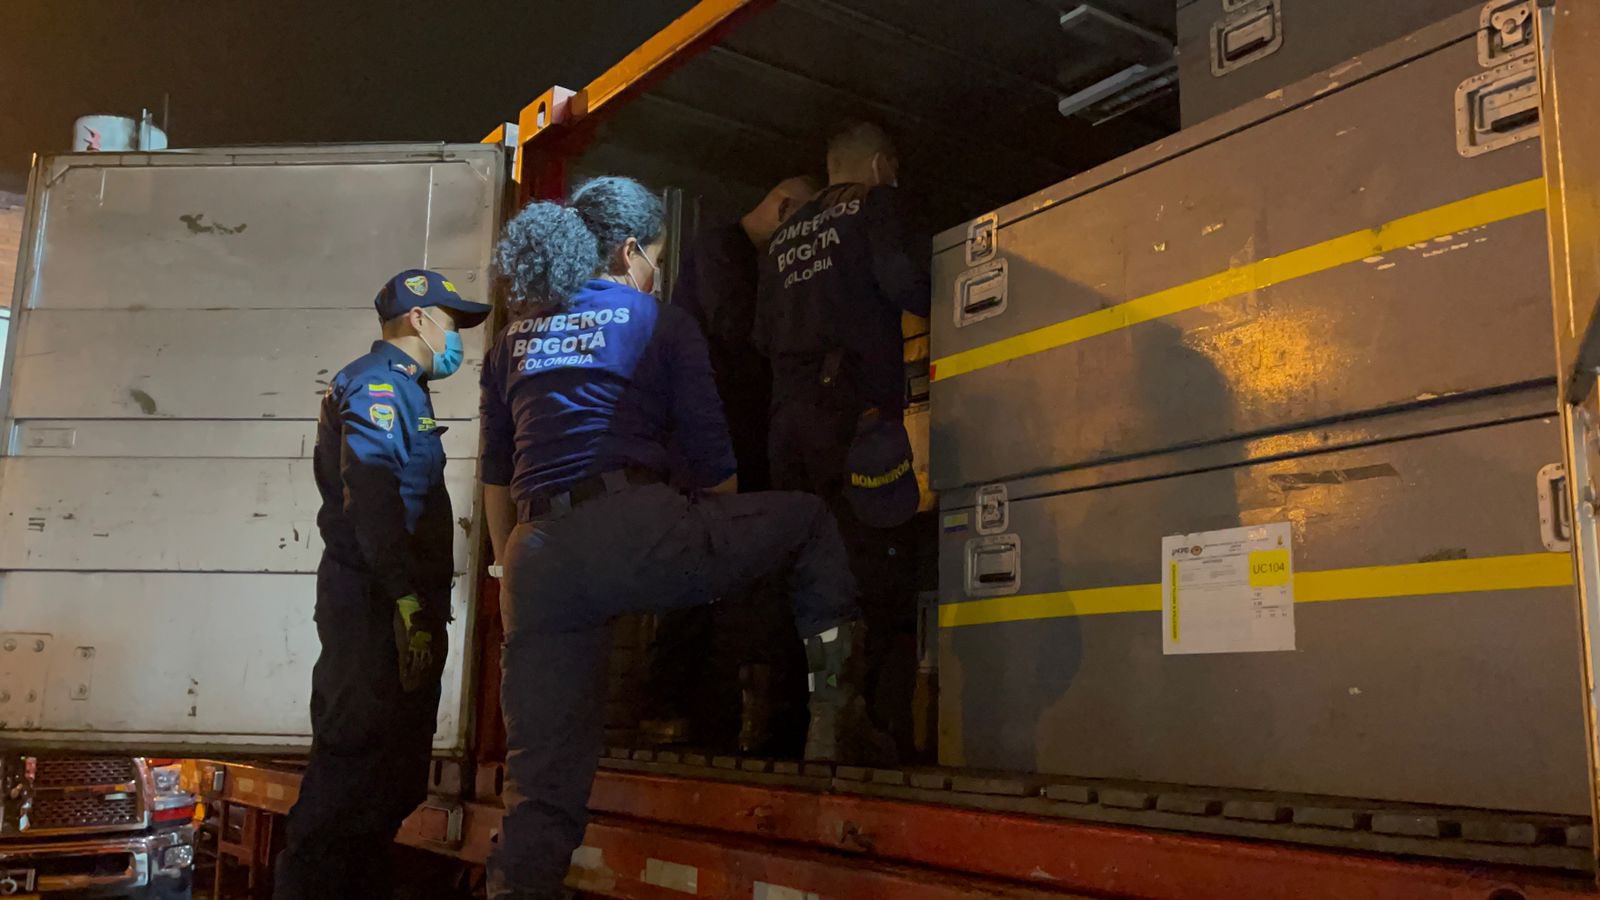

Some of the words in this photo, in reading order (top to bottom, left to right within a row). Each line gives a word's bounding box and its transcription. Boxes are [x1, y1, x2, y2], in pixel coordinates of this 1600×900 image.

[784, 256, 833, 289] COLOBIA
[507, 307, 630, 336] BOMBEROS
[513, 326, 607, 357] BOGOTÁ
[517, 354, 594, 371] COLOMBIA
[1252, 562, 1286, 575] UC104
